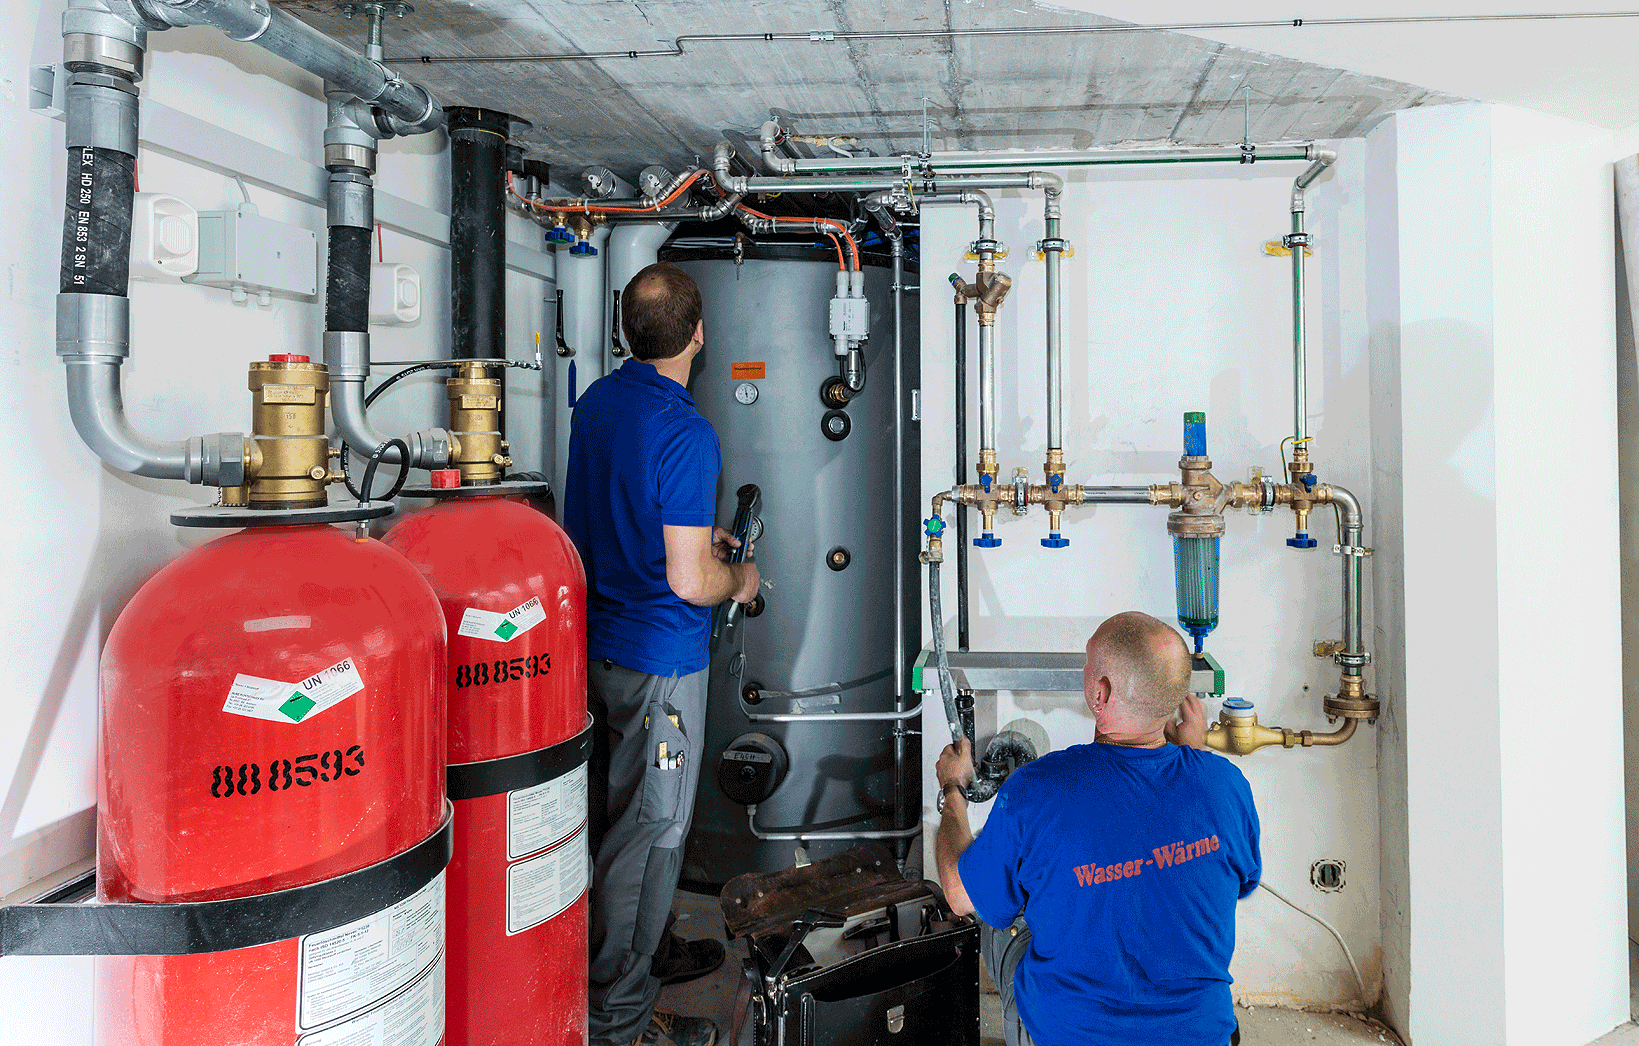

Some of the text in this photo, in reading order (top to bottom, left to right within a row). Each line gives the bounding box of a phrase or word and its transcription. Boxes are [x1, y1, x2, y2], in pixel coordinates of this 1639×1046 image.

[81, 173, 93, 187] HD
[80, 188, 92, 204] 250
[78, 211, 90, 224] EN
[76, 226, 89, 242] 853
[74, 254, 86, 268] SN
[73, 274, 85, 285] 51
[508, 598, 539, 619] UN 1066
[302, 660, 351, 690] UN 1066
